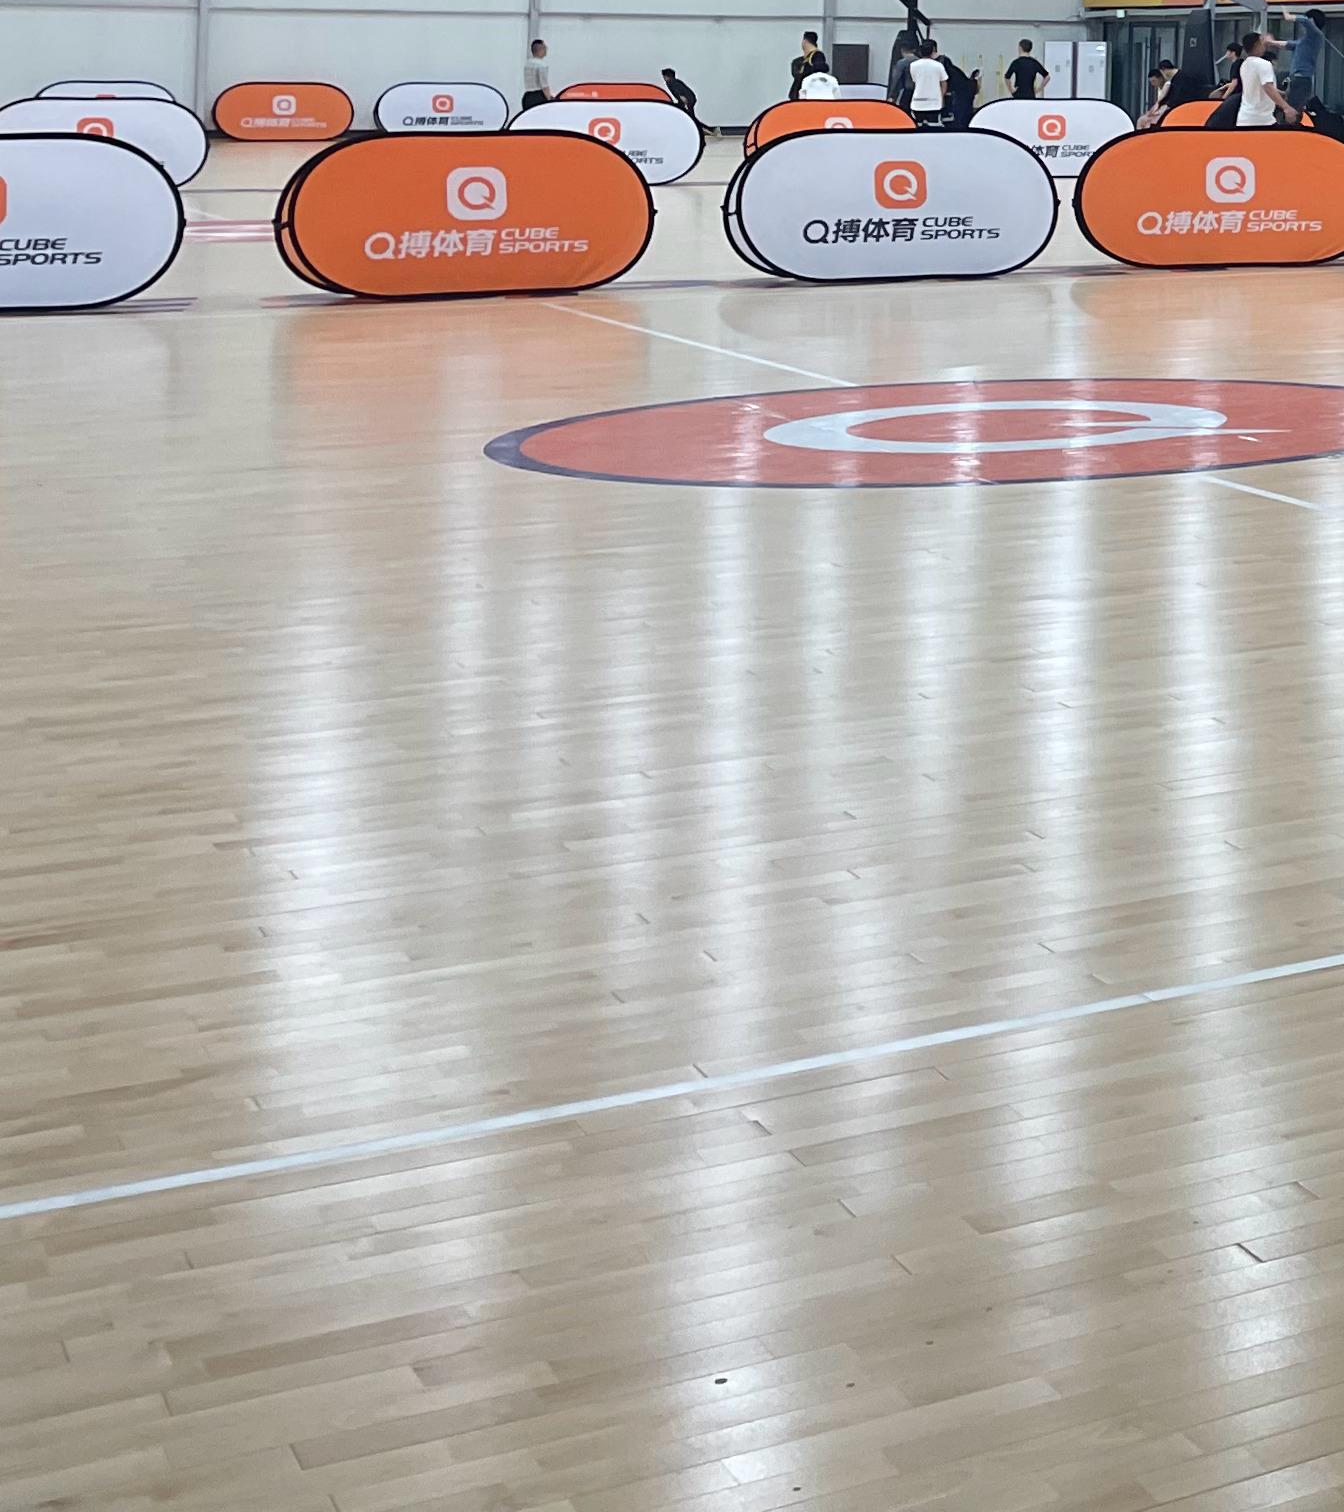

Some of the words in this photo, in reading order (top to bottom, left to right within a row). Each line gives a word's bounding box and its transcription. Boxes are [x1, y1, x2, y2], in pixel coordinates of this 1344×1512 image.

[1026, 145, 1060, 158] 体育
[922, 216, 973, 227] CUBE
[1249, 209, 1298, 221] CUBE
[1247, 221, 1322, 232] SPORTS
[501, 227, 559, 240] CUBE
[920, 228, 1000, 240] SPORTS
[0, 238, 67, 251] CUBE
[499, 240, 589, 254] SPORTS
[0, 252, 103, 265] SPORTS
